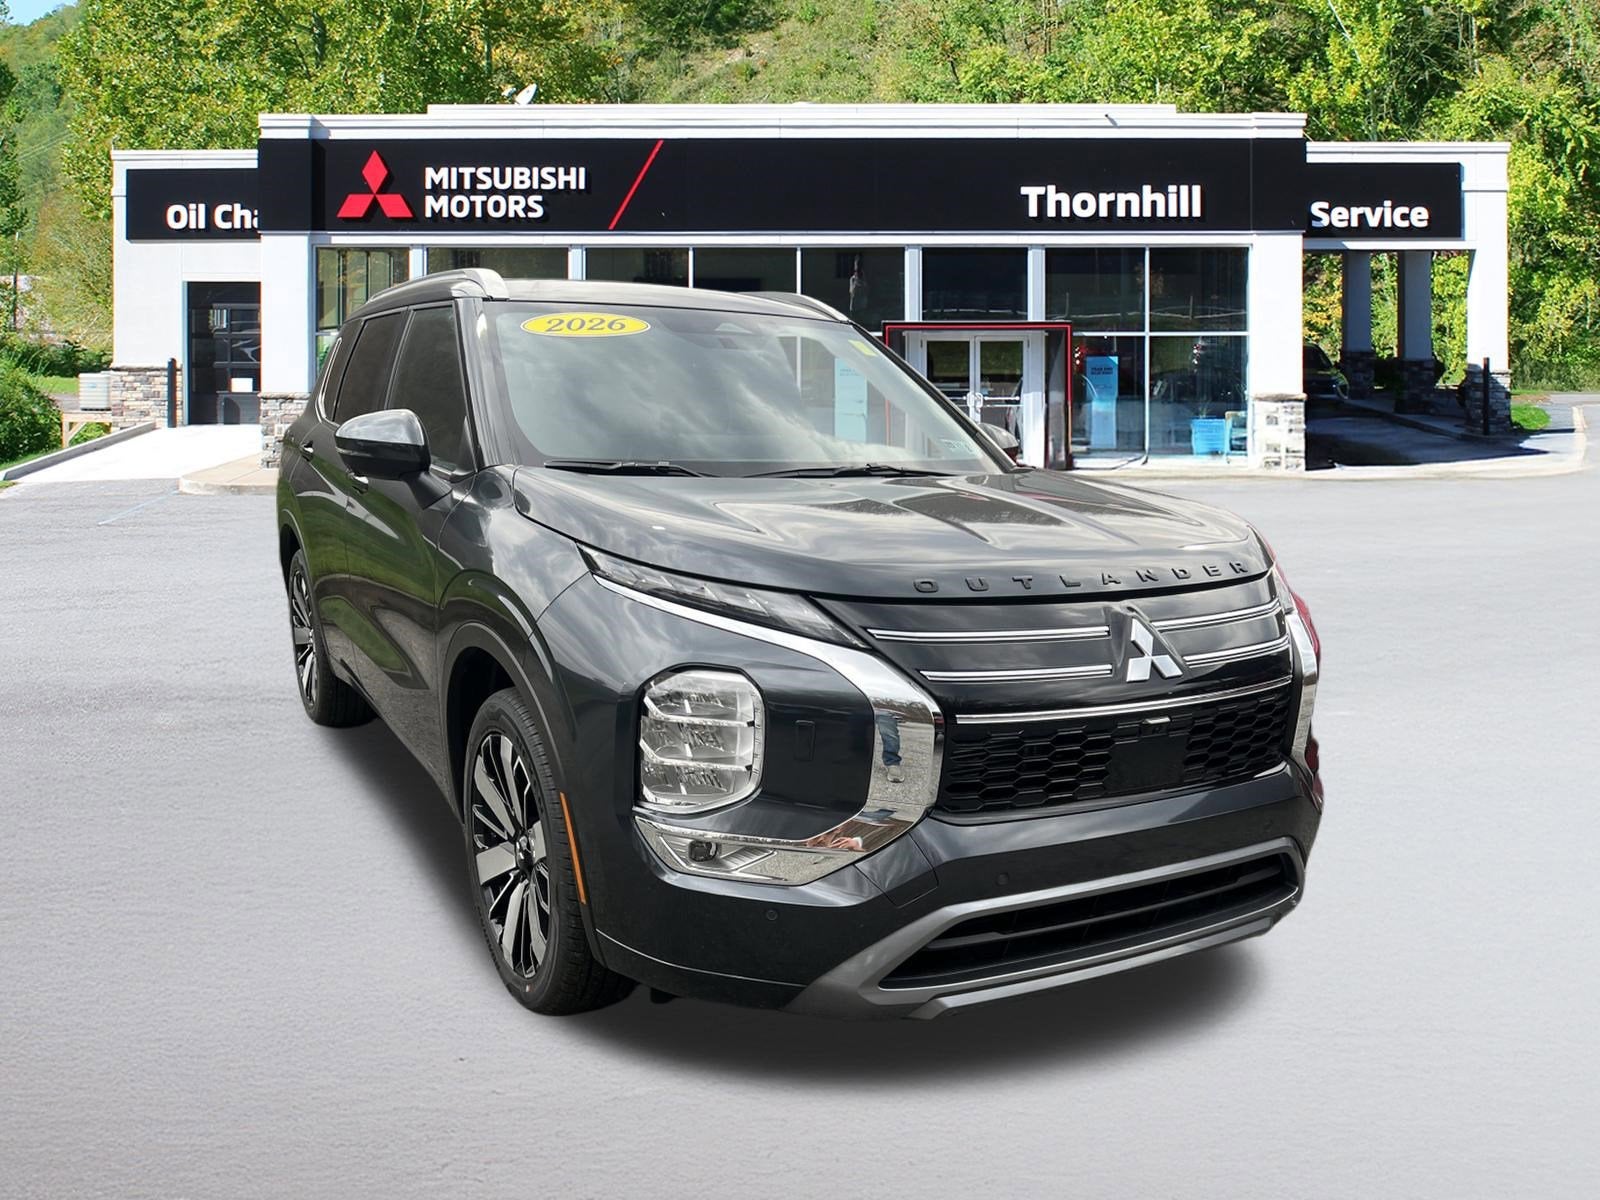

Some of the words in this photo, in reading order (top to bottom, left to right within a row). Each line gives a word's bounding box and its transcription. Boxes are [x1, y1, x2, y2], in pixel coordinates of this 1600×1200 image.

[425, 166, 586, 190] MITSUBISHI
[425, 194, 544, 218] MOTORS
[1020, 184, 1202, 218] Thornhill
[1310, 200, 1429, 228] Service
[166, 203, 206, 230] Oil
[545, 317, 627, 332] 2026
[913, 560, 1249, 594] OUTLANDER
